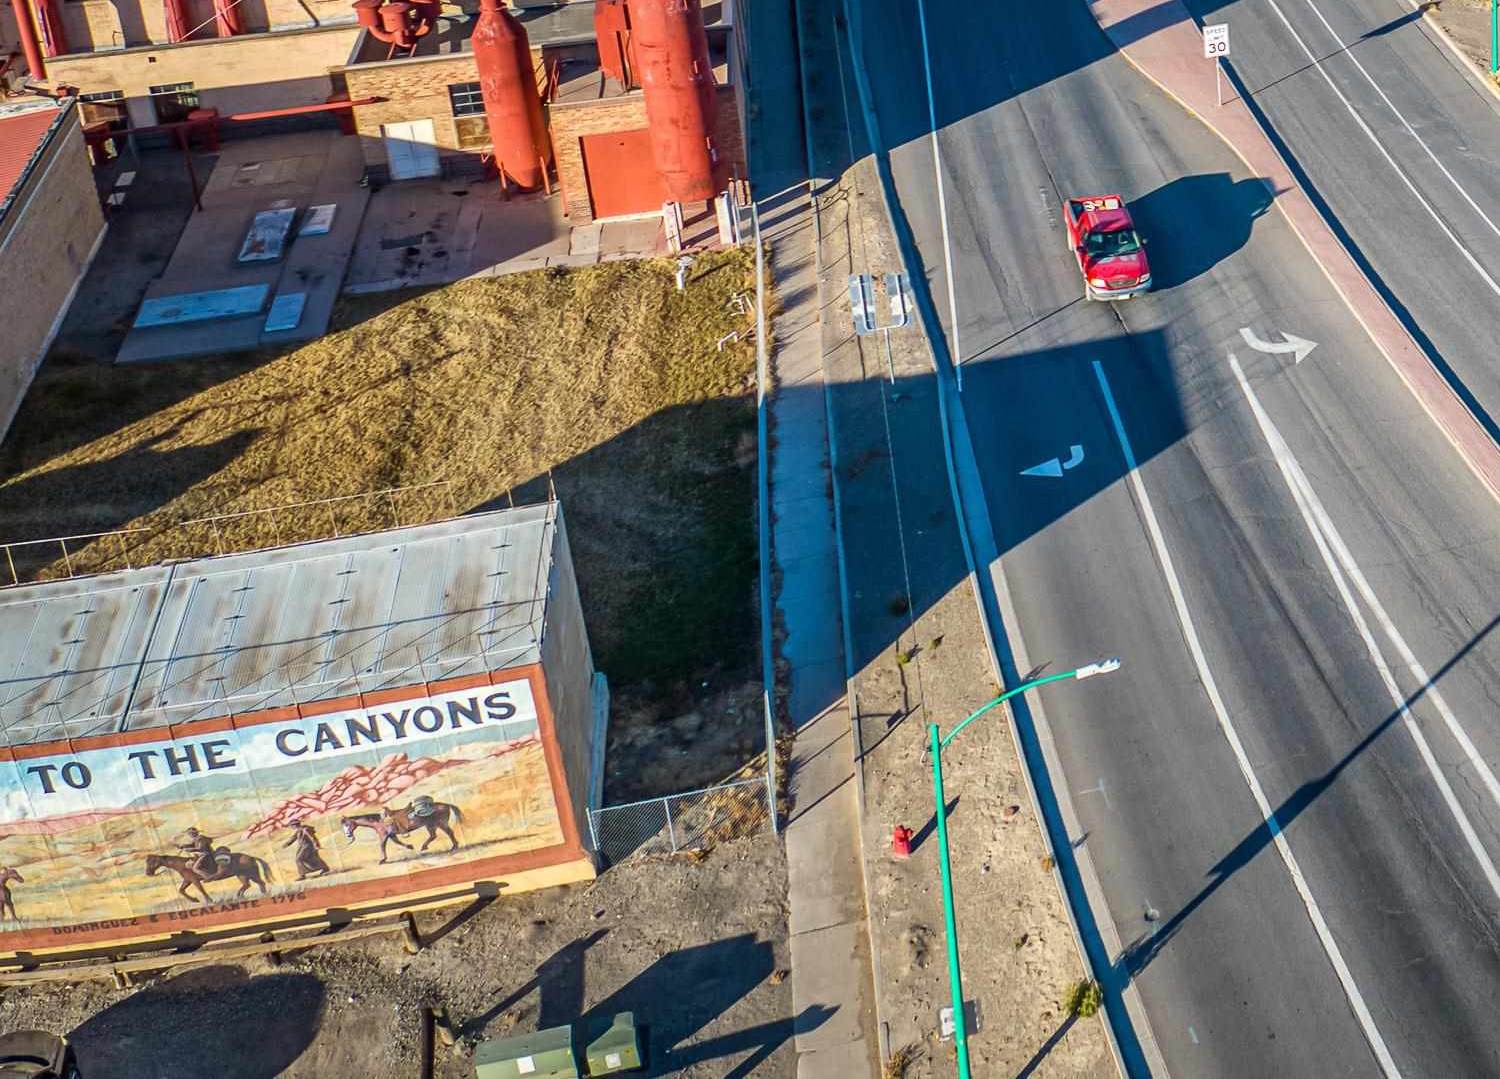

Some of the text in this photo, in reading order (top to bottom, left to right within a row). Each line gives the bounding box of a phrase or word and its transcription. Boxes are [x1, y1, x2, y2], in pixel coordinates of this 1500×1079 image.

[1208, 41, 1226, 54] 30
[27, 691, 518, 794] TO THE CANYONS
[168, 899, 260, 921] ESCALANTE
[271, 892, 307, 904] 1776
